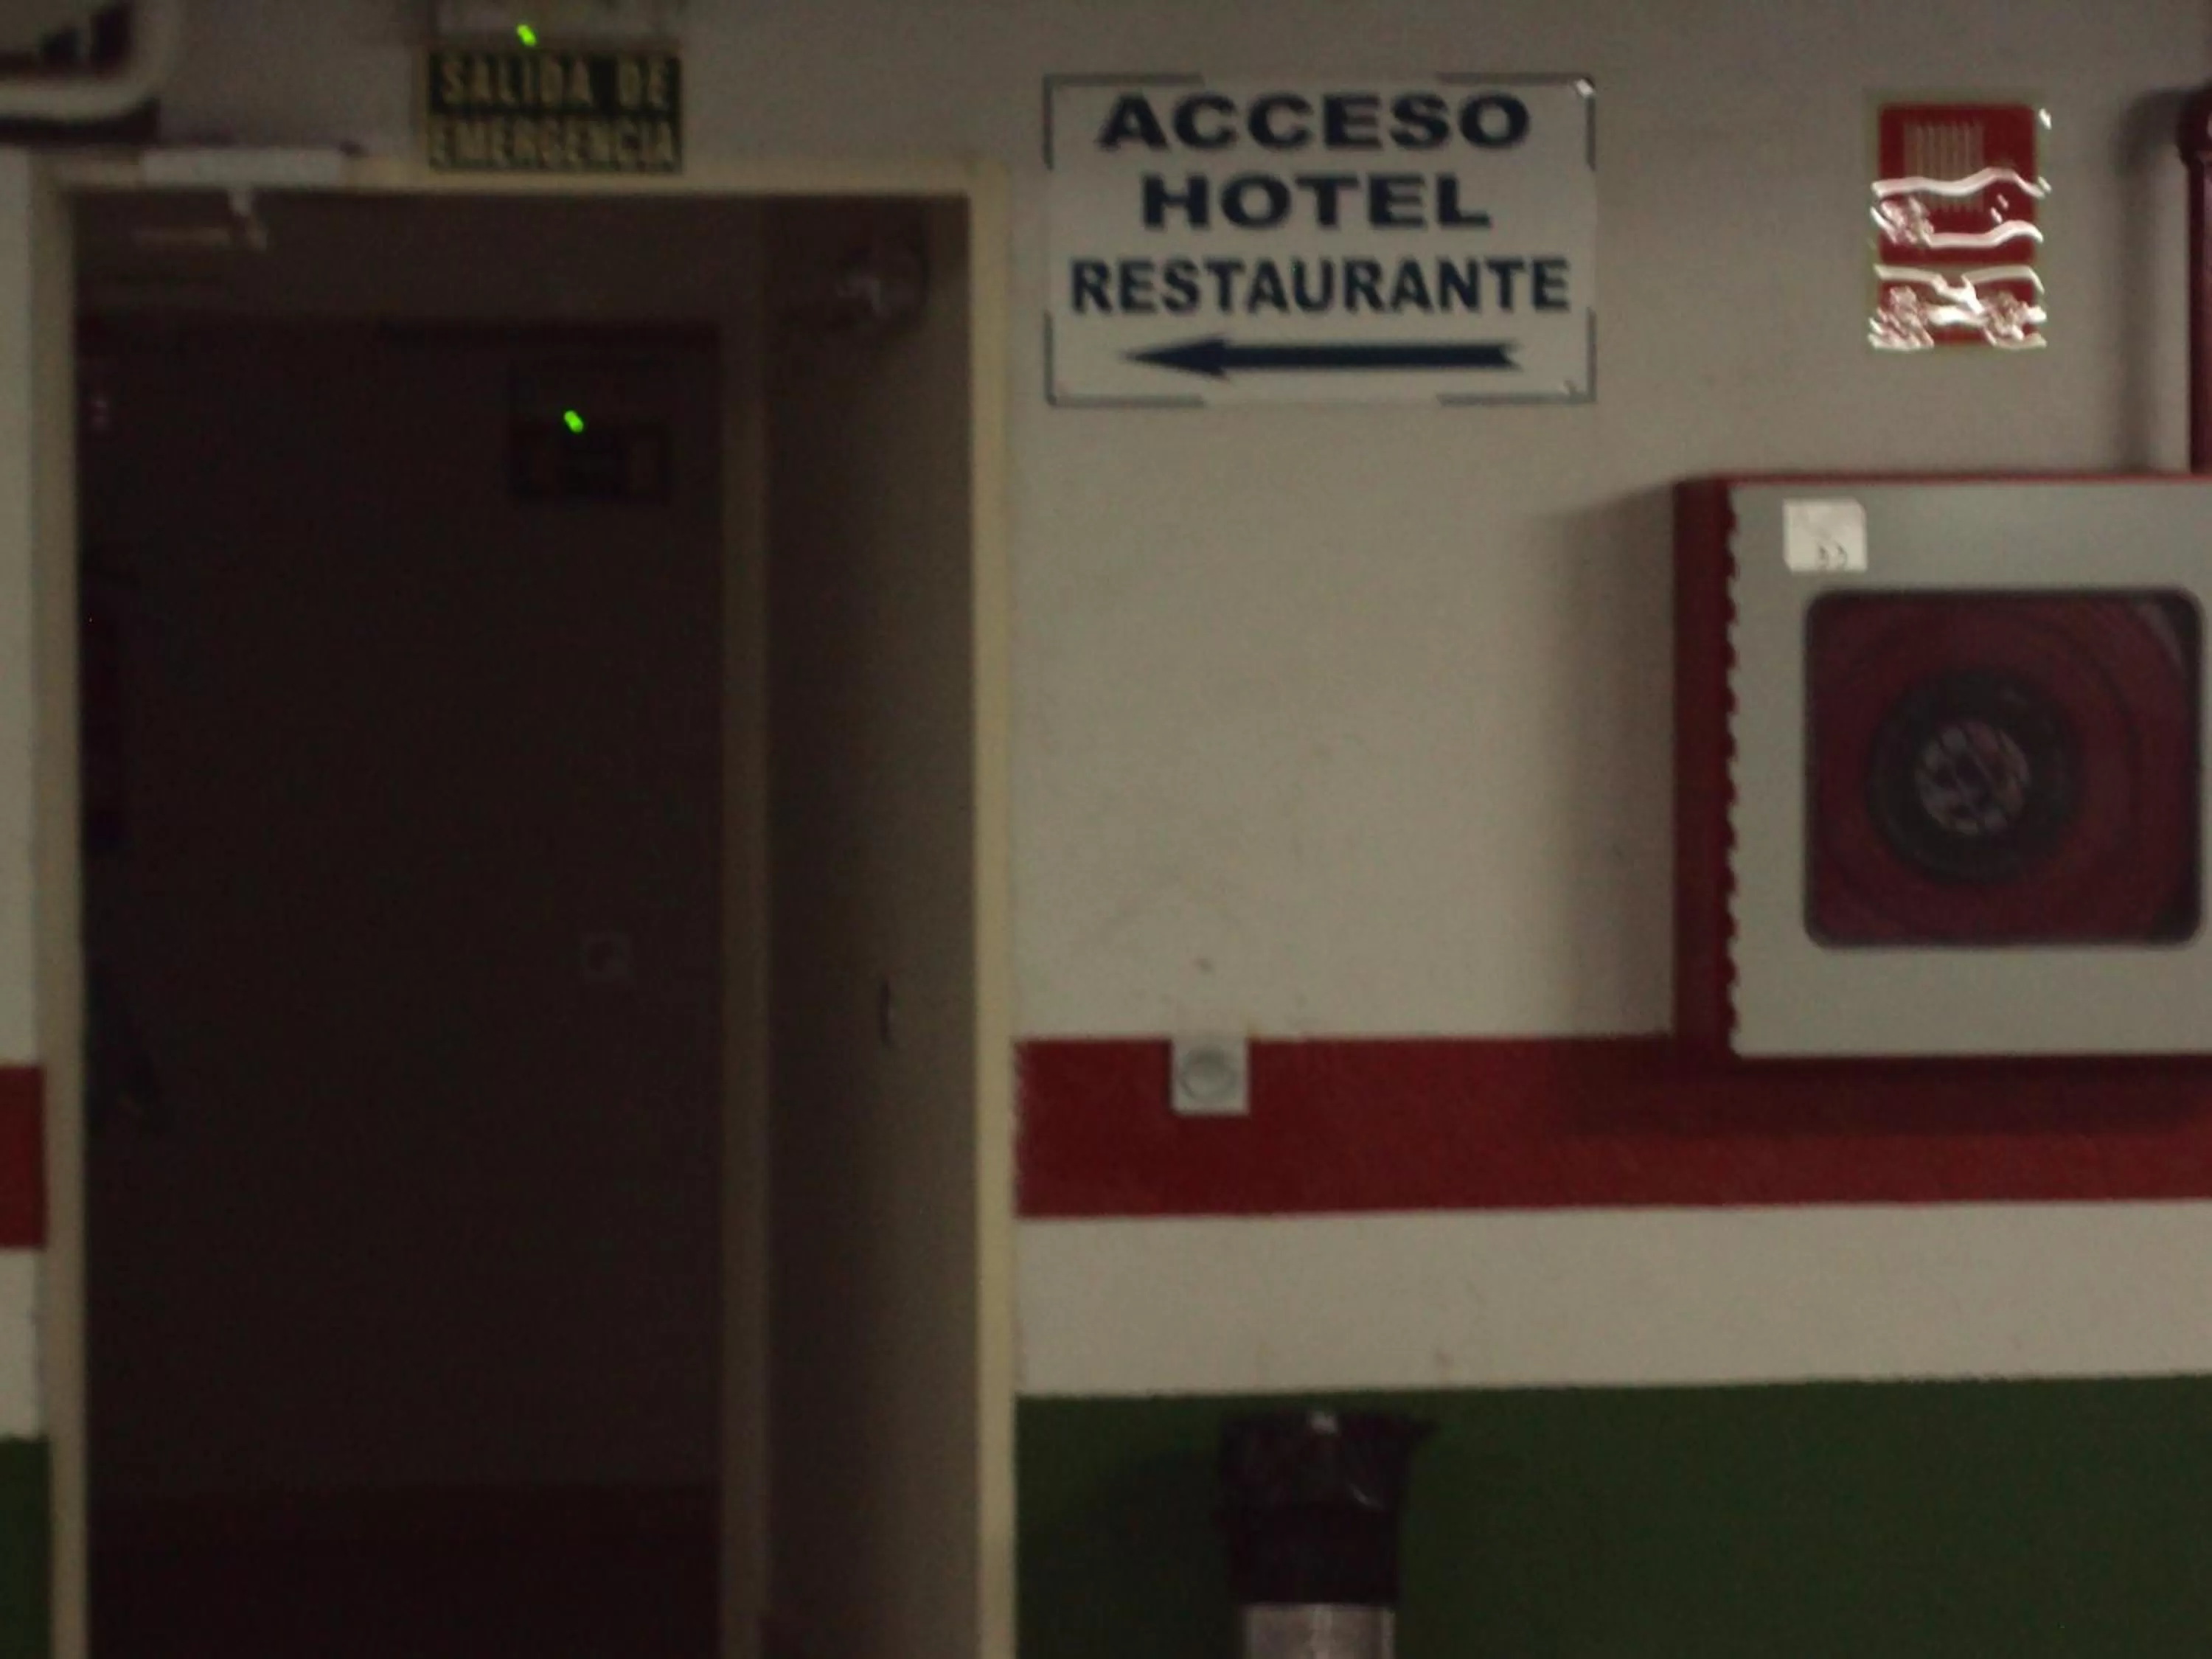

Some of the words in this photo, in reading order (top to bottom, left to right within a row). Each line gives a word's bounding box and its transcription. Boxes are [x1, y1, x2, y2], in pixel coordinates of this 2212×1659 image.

[441, 54, 593, 106] SALIDA
[615, 56, 669, 109] DE
[430, 115, 675, 168] EMERGENCIA
[1101, 91, 1531, 149] ACCESO
[1142, 175, 1492, 228] HOTEL
[1071, 256, 1571, 312] RESTAURANTE
